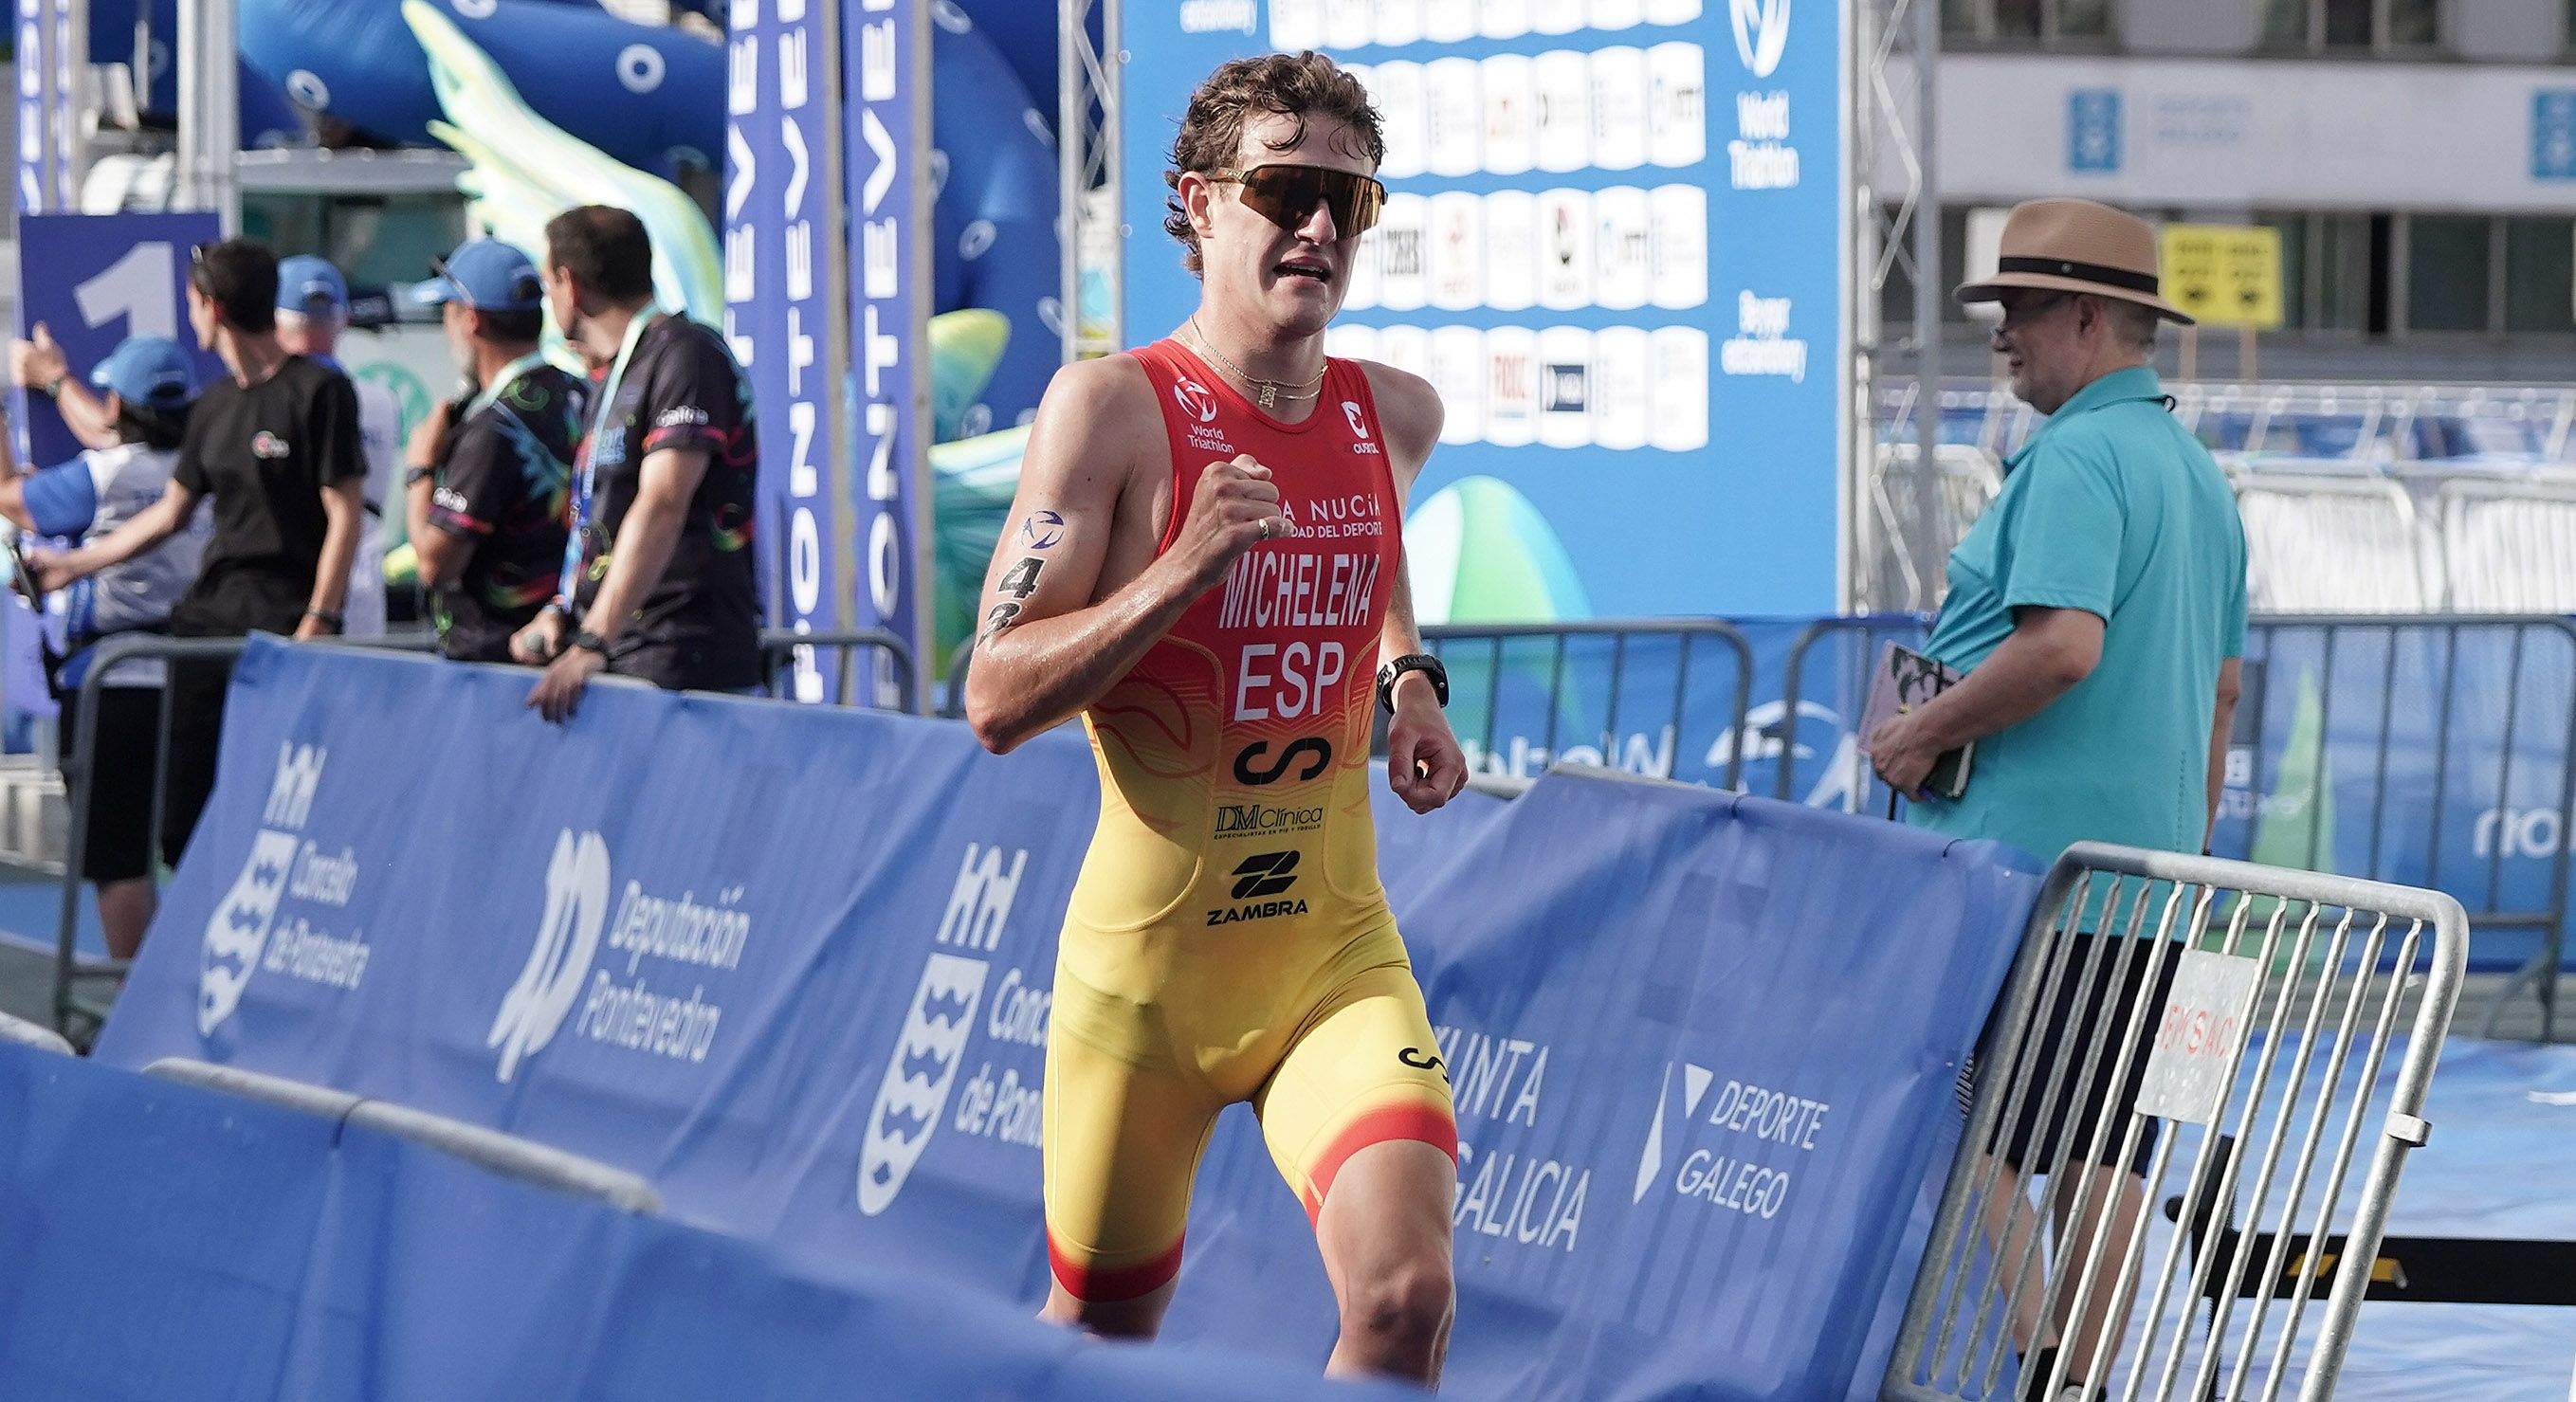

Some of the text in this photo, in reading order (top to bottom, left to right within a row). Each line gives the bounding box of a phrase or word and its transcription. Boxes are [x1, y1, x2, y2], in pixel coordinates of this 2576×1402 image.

[72, 240, 179, 340] 1
[861, 0, 901, 710] PONTEVE
[1187, 434, 1235, 454] Triathlon
[1190, 423, 1225, 440] World
[1289, 524, 1315, 538] DAD
[1318, 524, 1340, 538] DEL
[1218, 550, 1380, 629] MICHELENA
[1233, 641, 1345, 721] ESP
[1206, 900, 1308, 927] ZAMBRA
[575, 967, 722, 1064] Pontevedra
[1708, 1079, 1830, 1152] DEPORTE
[1674, 1147, 1791, 1221] GALEGO
